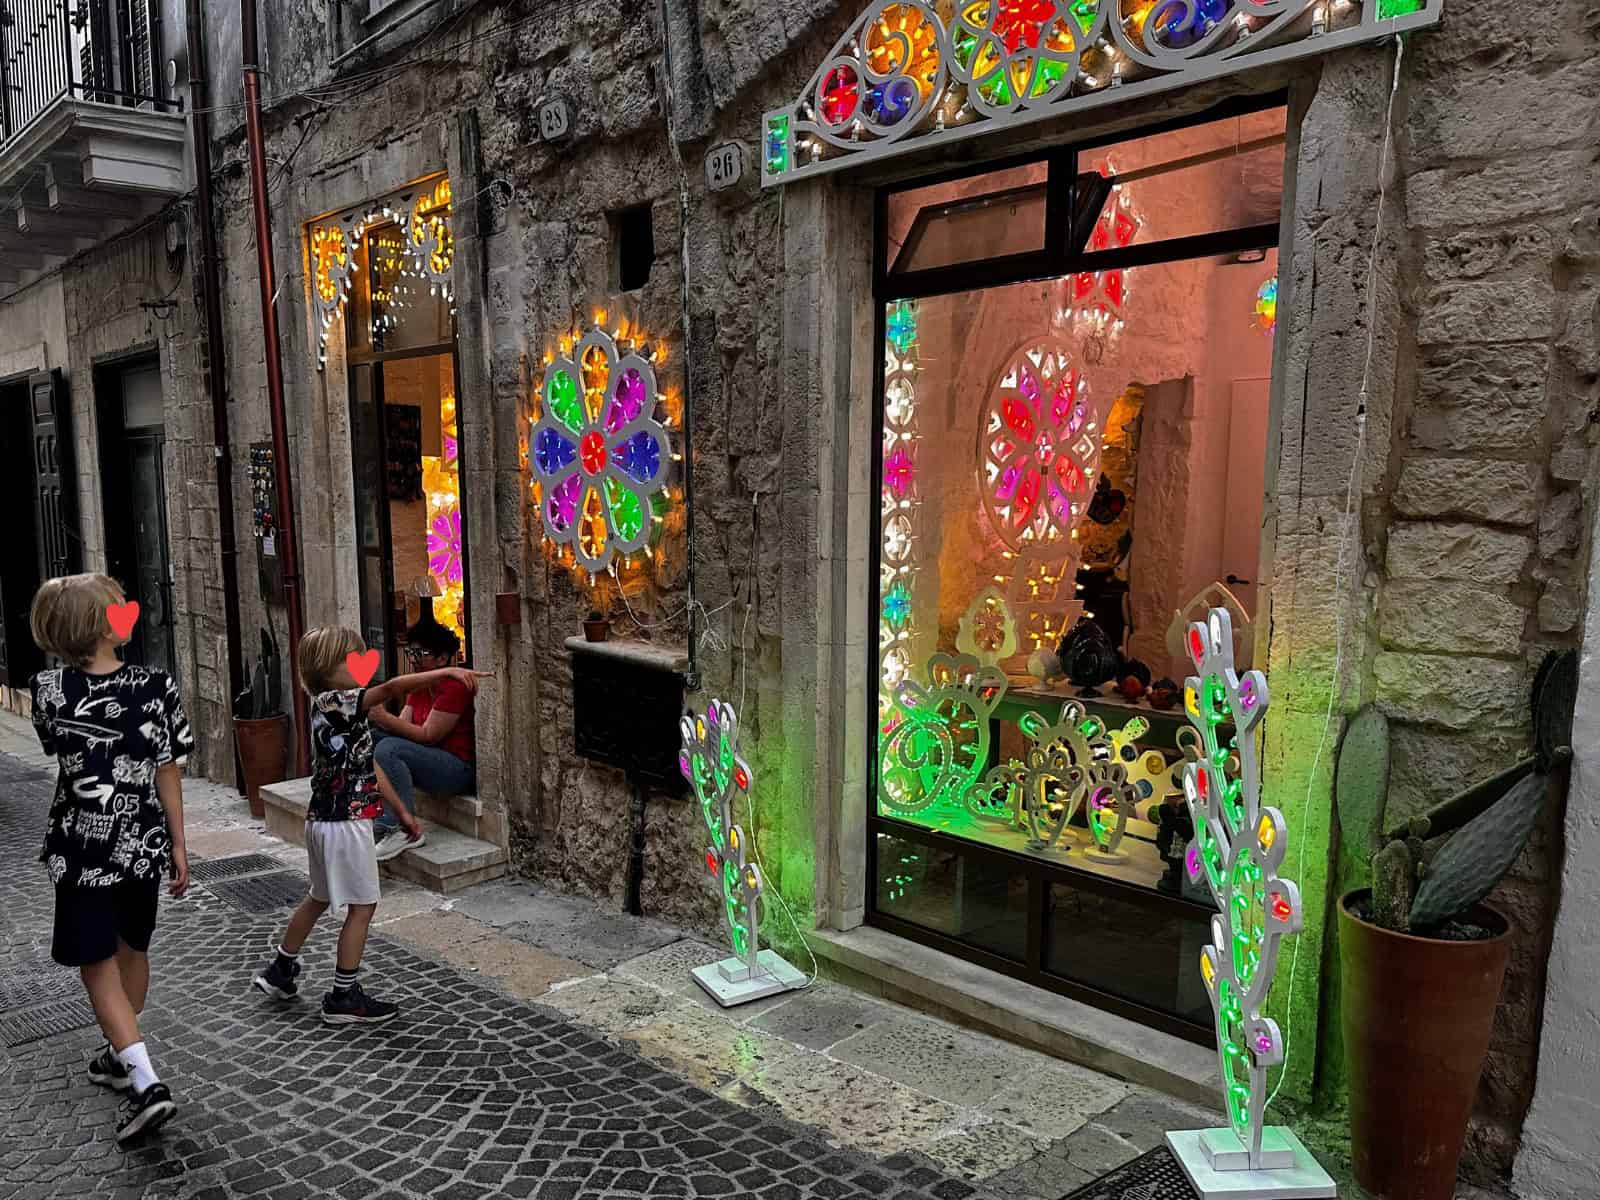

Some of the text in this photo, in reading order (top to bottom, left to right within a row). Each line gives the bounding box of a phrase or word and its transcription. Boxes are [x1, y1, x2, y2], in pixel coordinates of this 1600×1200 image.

[545, 105, 562, 131] 28
[712, 152, 733, 180] 26
[113, 793, 140, 814] 05
